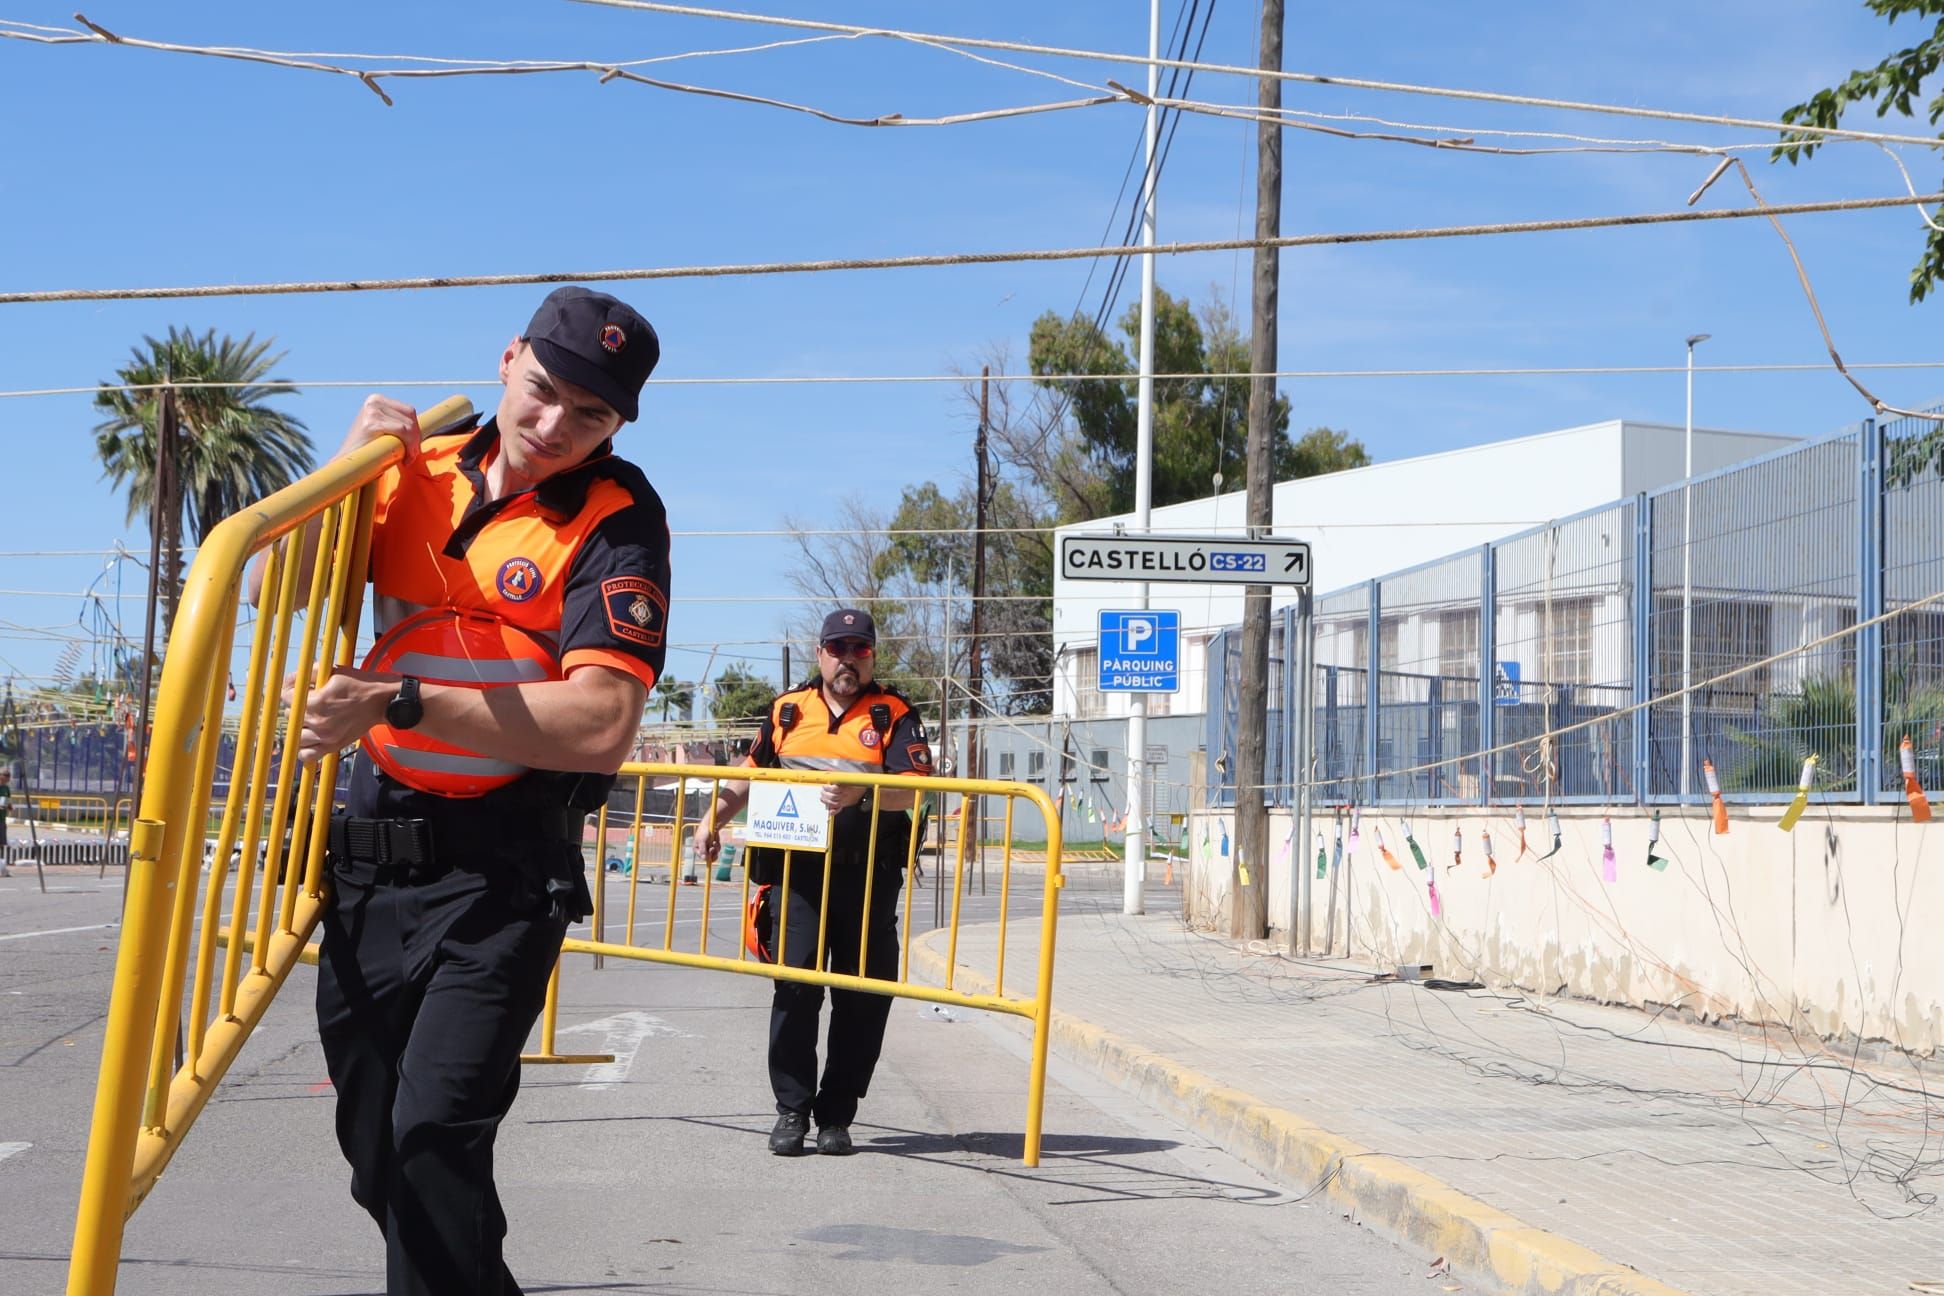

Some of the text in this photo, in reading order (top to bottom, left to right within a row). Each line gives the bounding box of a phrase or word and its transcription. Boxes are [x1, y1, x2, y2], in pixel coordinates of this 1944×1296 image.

[1069, 548, 1263, 571] CASTELLÓ CS-22
[1127, 619, 1153, 651] P
[1103, 658, 1174, 671] PÀRQUING
[1113, 673, 1162, 687] PÚBLIC
[753, 819, 797, 833] MAQUIVER,
